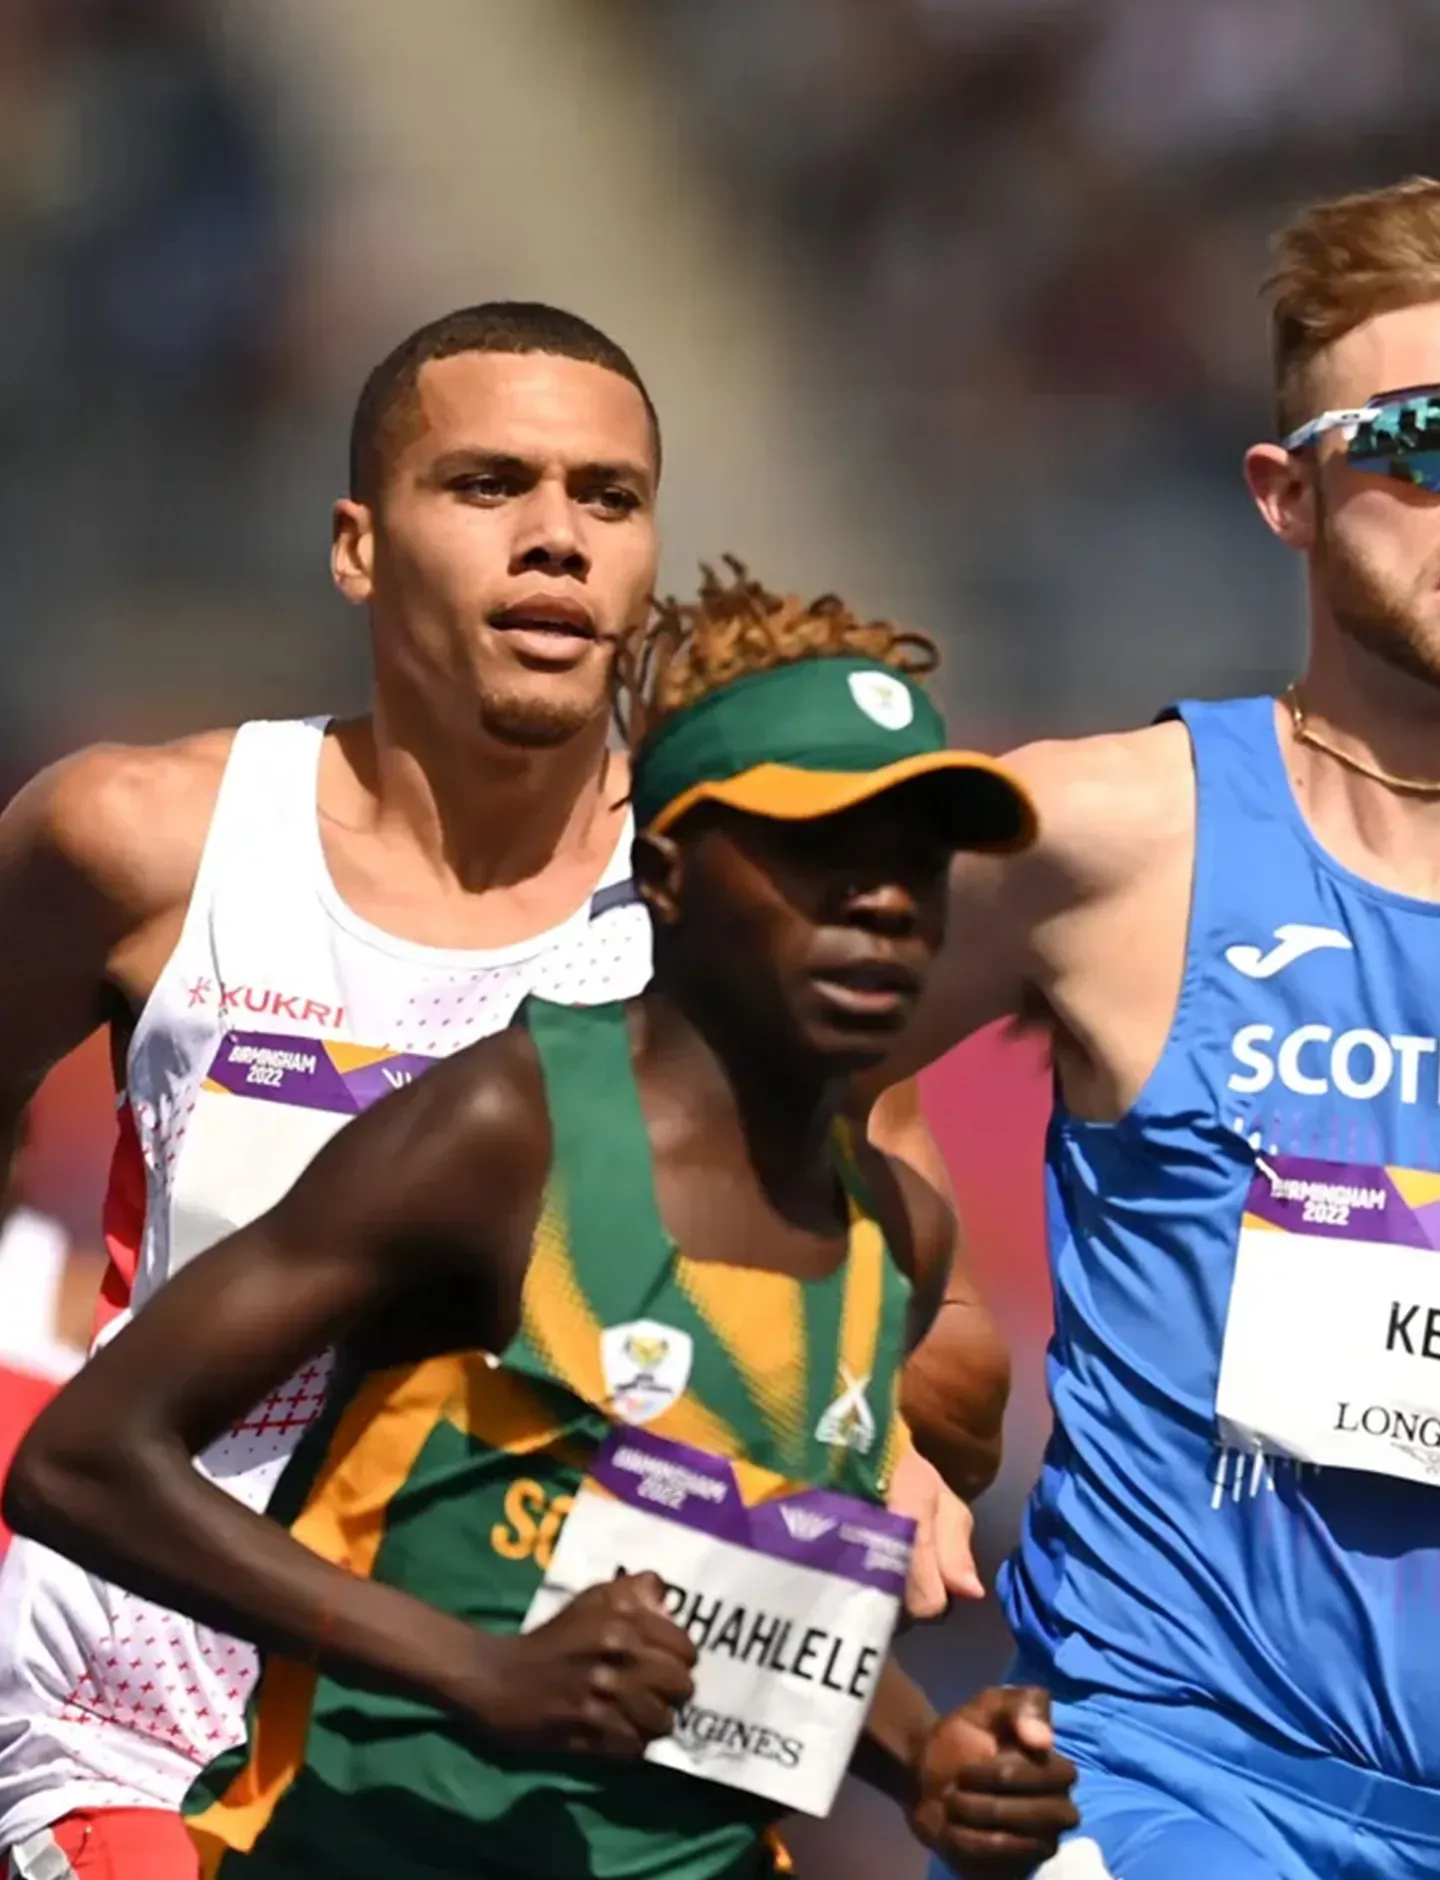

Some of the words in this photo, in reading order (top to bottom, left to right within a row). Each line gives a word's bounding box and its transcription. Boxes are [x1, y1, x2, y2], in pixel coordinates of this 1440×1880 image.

[218, 981, 345, 1028] KUKRI
[246, 1065, 284, 1087] 2022
[1302, 1202, 1350, 1225] 2022
[615, 1565, 879, 1700] HAHLELE
[673, 1700, 805, 1768] NGINES
